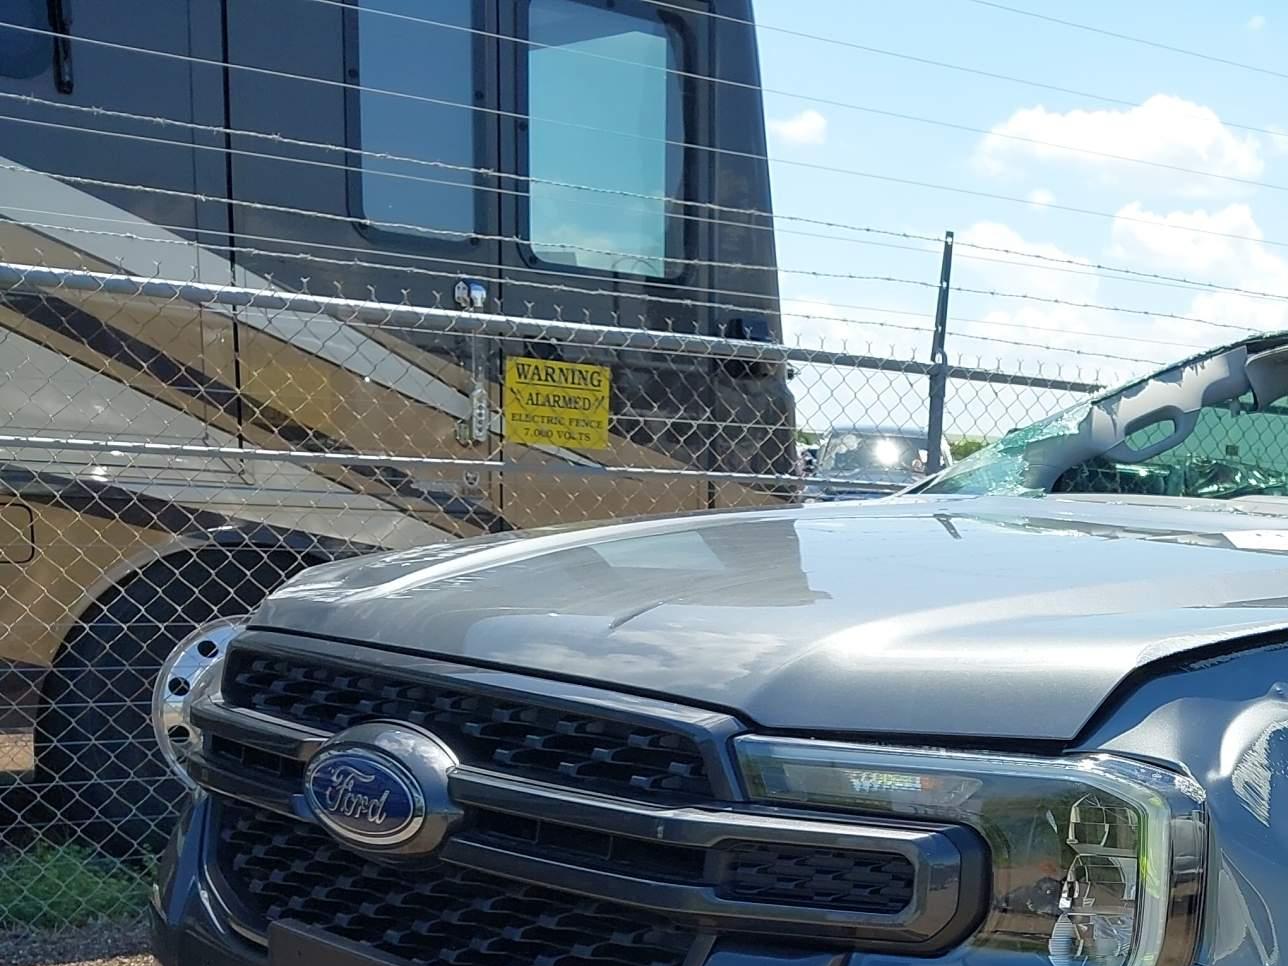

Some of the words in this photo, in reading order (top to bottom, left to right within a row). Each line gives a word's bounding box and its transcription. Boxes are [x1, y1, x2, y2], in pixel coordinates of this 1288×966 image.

[515, 363, 602, 387] WARNING
[527, 392, 591, 411] ALARMED
[511, 412, 566, 425] ELECTRIC
[569, 418, 602, 429] FENCE
[326, 765, 390, 824] Ford
